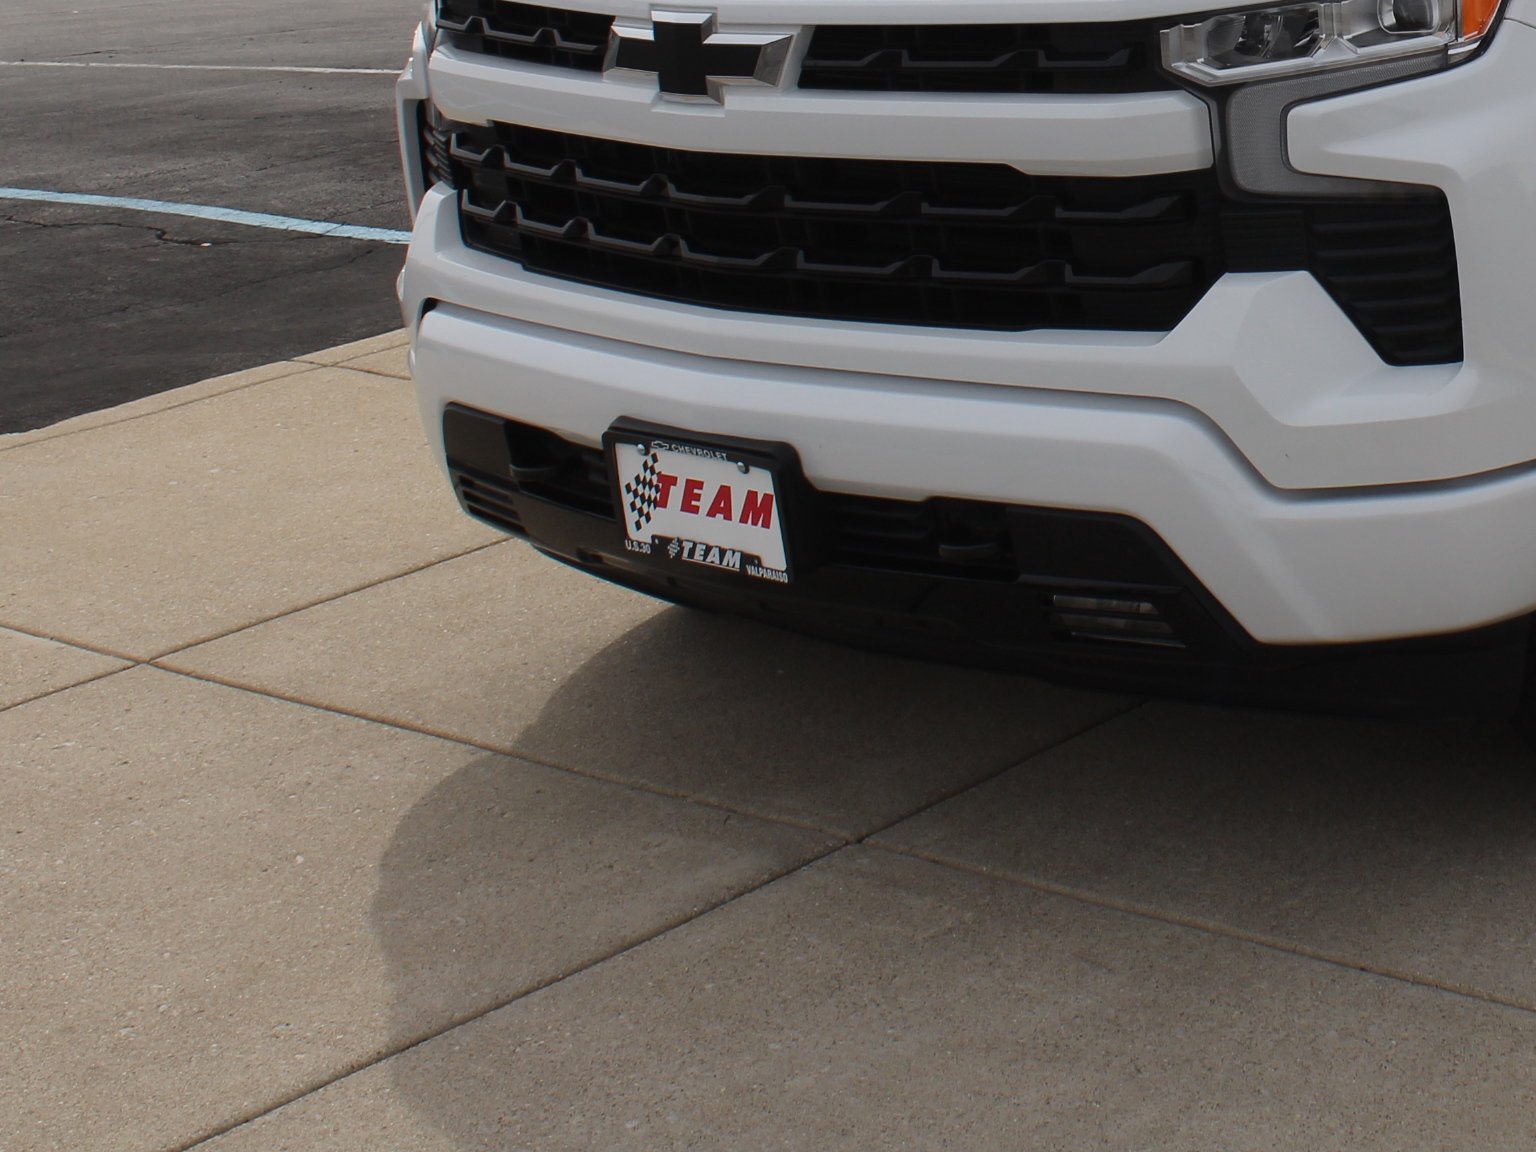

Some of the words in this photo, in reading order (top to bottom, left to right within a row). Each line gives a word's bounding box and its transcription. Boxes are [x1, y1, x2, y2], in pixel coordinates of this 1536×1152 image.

[670, 443, 728, 461] CHEVROLET
[656, 472, 774, 530] TEAM
[682, 539, 742, 569] TEAM
[746, 564, 788, 584] VALPARAISO
